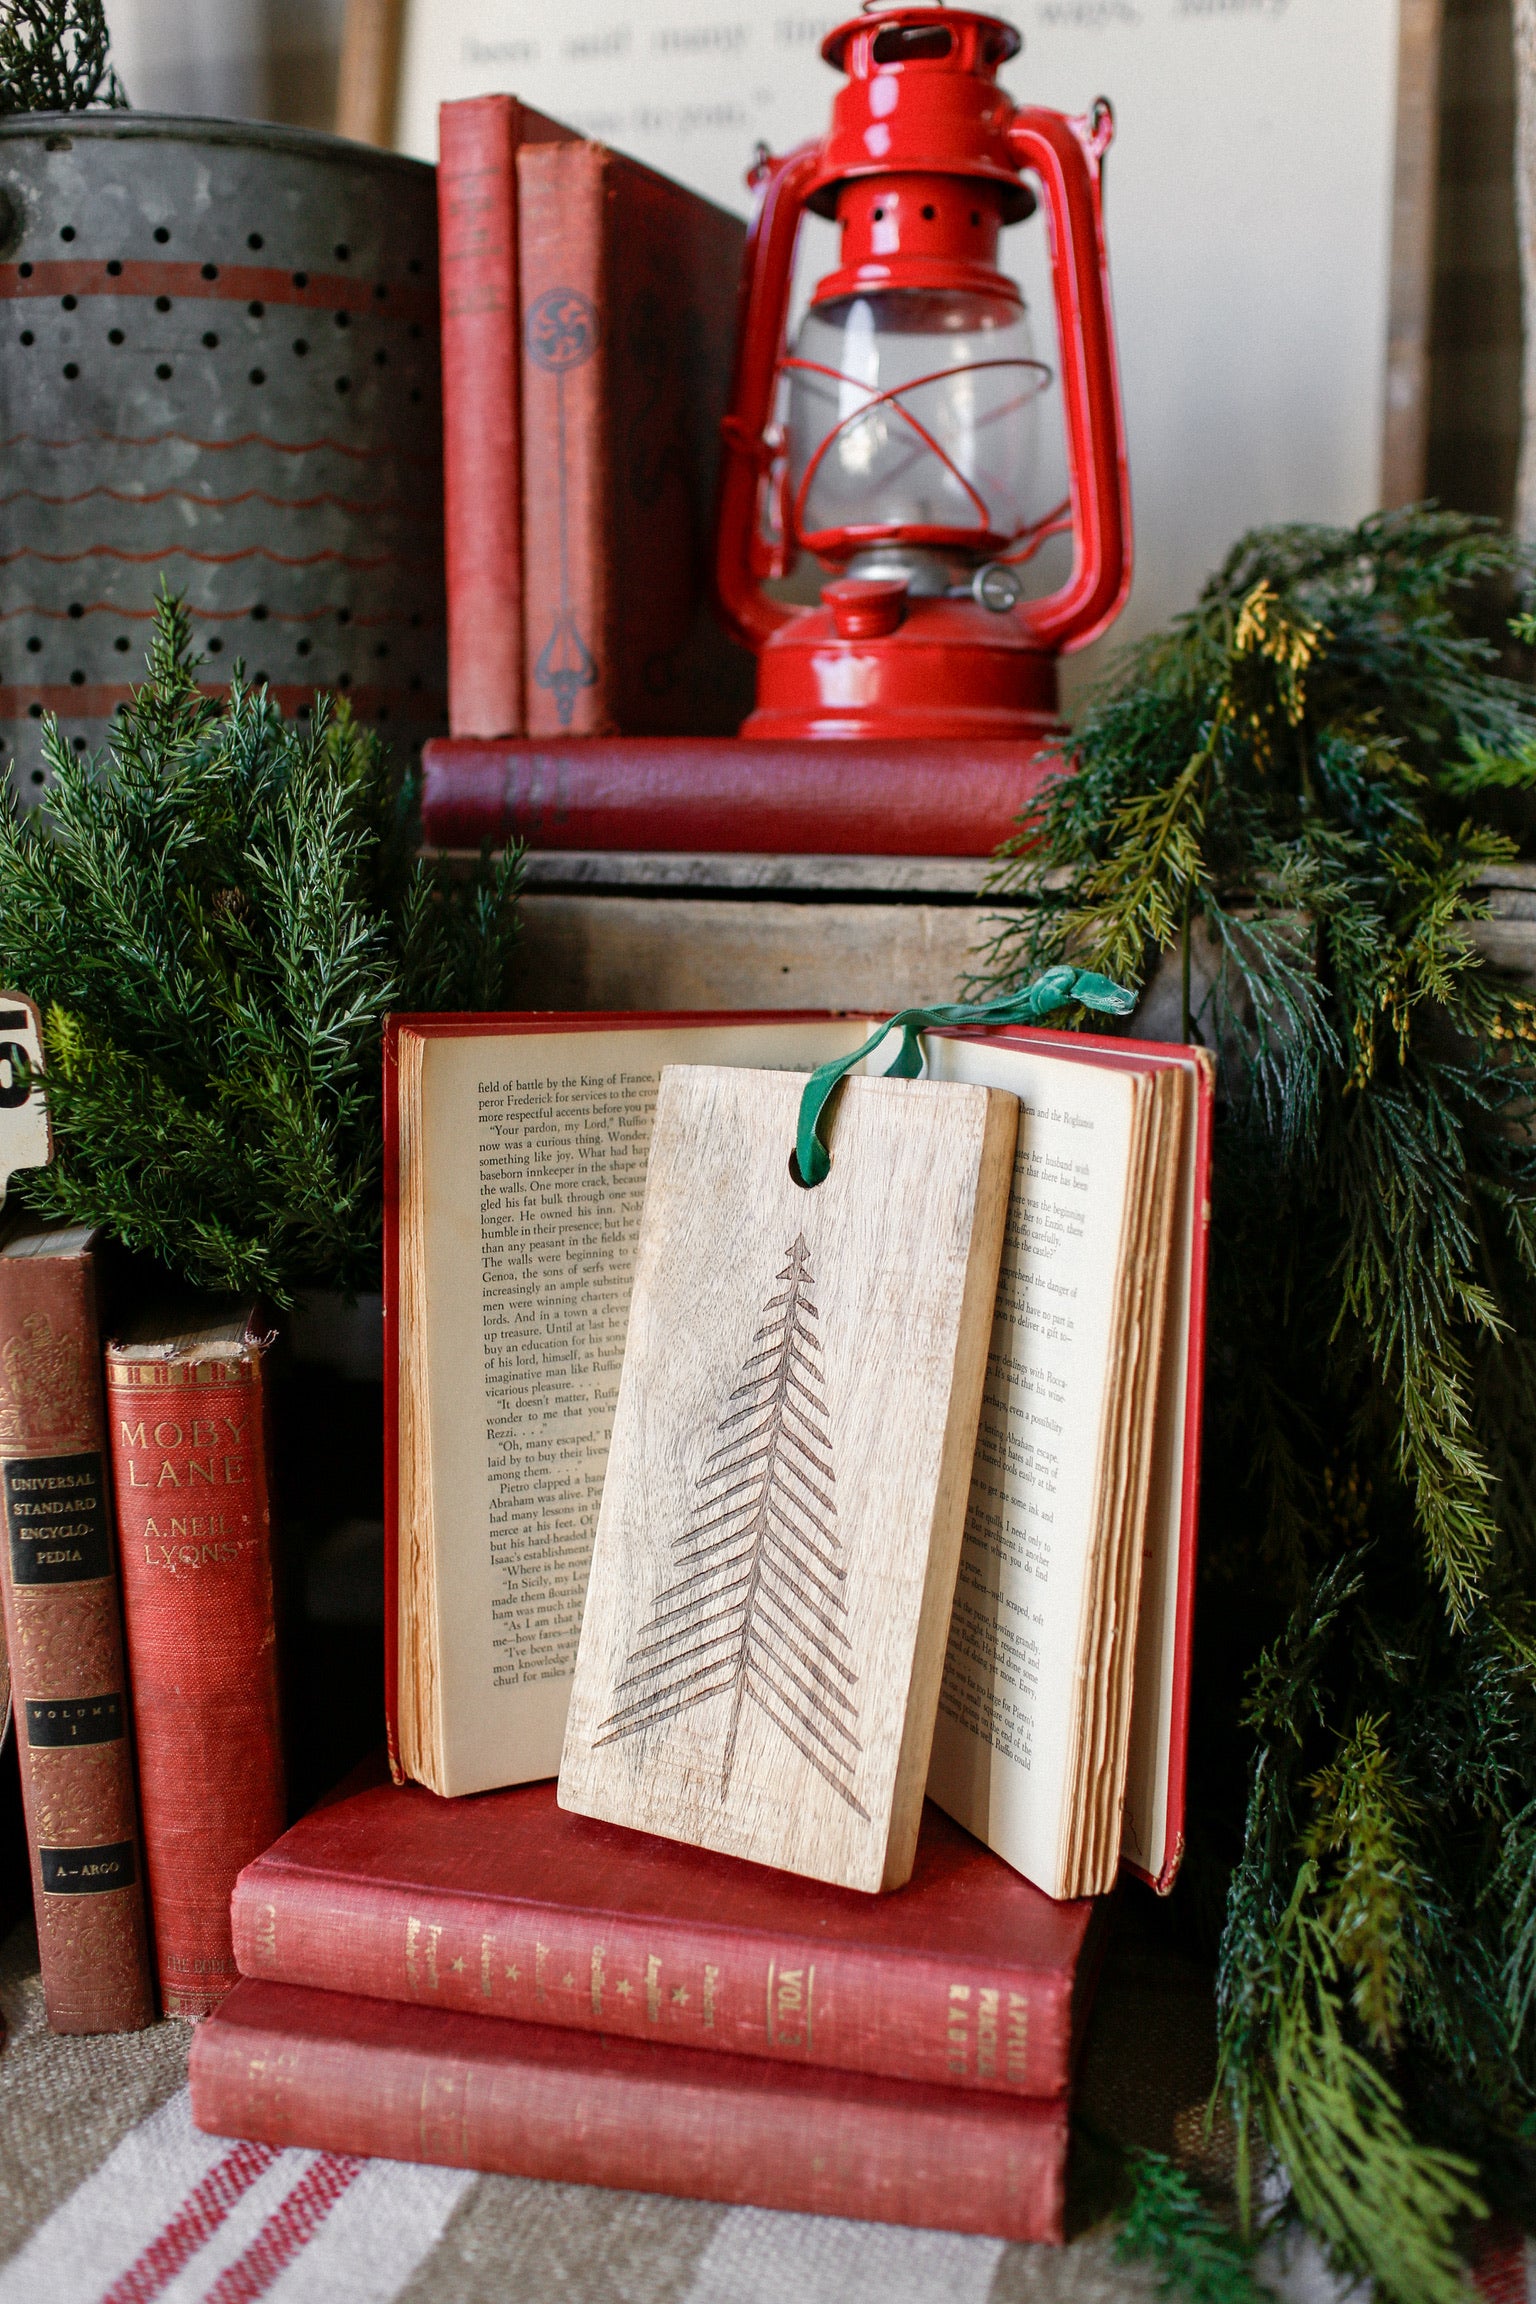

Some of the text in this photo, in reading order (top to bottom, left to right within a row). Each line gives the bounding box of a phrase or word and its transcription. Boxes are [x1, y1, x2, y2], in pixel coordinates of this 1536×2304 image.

[477, 1081, 501, 1092] field
[502, 1080, 512, 1091] of
[516, 1079, 543, 1090] battle
[546, 1078, 558, 1091] by
[561, 1077, 576, 1087] the
[580, 1076, 603, 1088] King
[606, 1074, 616, 1084] of
[478, 1087, 636, 1111] peror Frederick for services to the
[478, 1103, 641, 1122] more respectful accents before you
[564, 1123, 579, 1133] my
[618, 1116, 646, 1127] Ruffio
[479, 1143, 500, 1151] now
[536, 1137, 571, 1147] curious
[479, 1153, 529, 1166] something
[534, 1151, 551, 1162] like
[579, 1147, 605, 1158] What
[610, 1145, 627, 1156] had
[480, 1158, 648, 1180] baseborn innkeeper in the shape of
[480, 1184, 496, 1195] the
[529, 1180, 551, 1191] One
[554, 1181, 578, 1189] more
[480, 1198, 501, 1213] gled
[505, 1197, 519, 1207] his
[523, 1196, 536, 1206] fat
[541, 1193, 563, 1205] bulk
[566, 1190, 604, 1204] through
[520, 1210, 535, 1221] He
[540, 1207, 572, 1219] owned
[577, 1206, 591, 1216] his
[522, 1268, 538, 1278] the
[542, 1269, 563, 1277] sons
[567, 1264, 577, 1274] of
[582, 1262, 604, 1273] serfs
[608, 1263, 630, 1271] were
[514, 1311, 535, 1322] And
[539, 1312, 549, 1320] in
[563, 1309, 587, 1318] town
[601, 1304, 630, 1314] clever
[484, 1344, 502, 1356] buy
[521, 1339, 568, 1351] education
[571, 1336, 585, 1345] for
[588, 1334, 602, 1344] his
[605, 1334, 625, 1342] sons
[485, 1360, 621, 1384] imaginative man like Ruffio
[120, 1416, 248, 1449] MOBY
[128, 1456, 246, 1488] LANE
[11, 1473, 95, 1491] UNIVERSAL
[500, 1475, 570, 1493] Pietro clapped
[13, 1498, 97, 1516] STANDARD
[488, 1496, 534, 1509] Abraham
[537, 1495, 555, 1503] was
[20, 1524, 95, 1540] ENCYCLO-
[36, 1549, 82, 1564] PEDIA
[143, 1540, 240, 1566] LYONS
[491, 1584, 584, 1606] made them flourish
[33, 1704, 117, 1721] VOLUME
[777, 1969, 803, 2020] VOL.
[948, 1983, 971, 2075] RADIO
